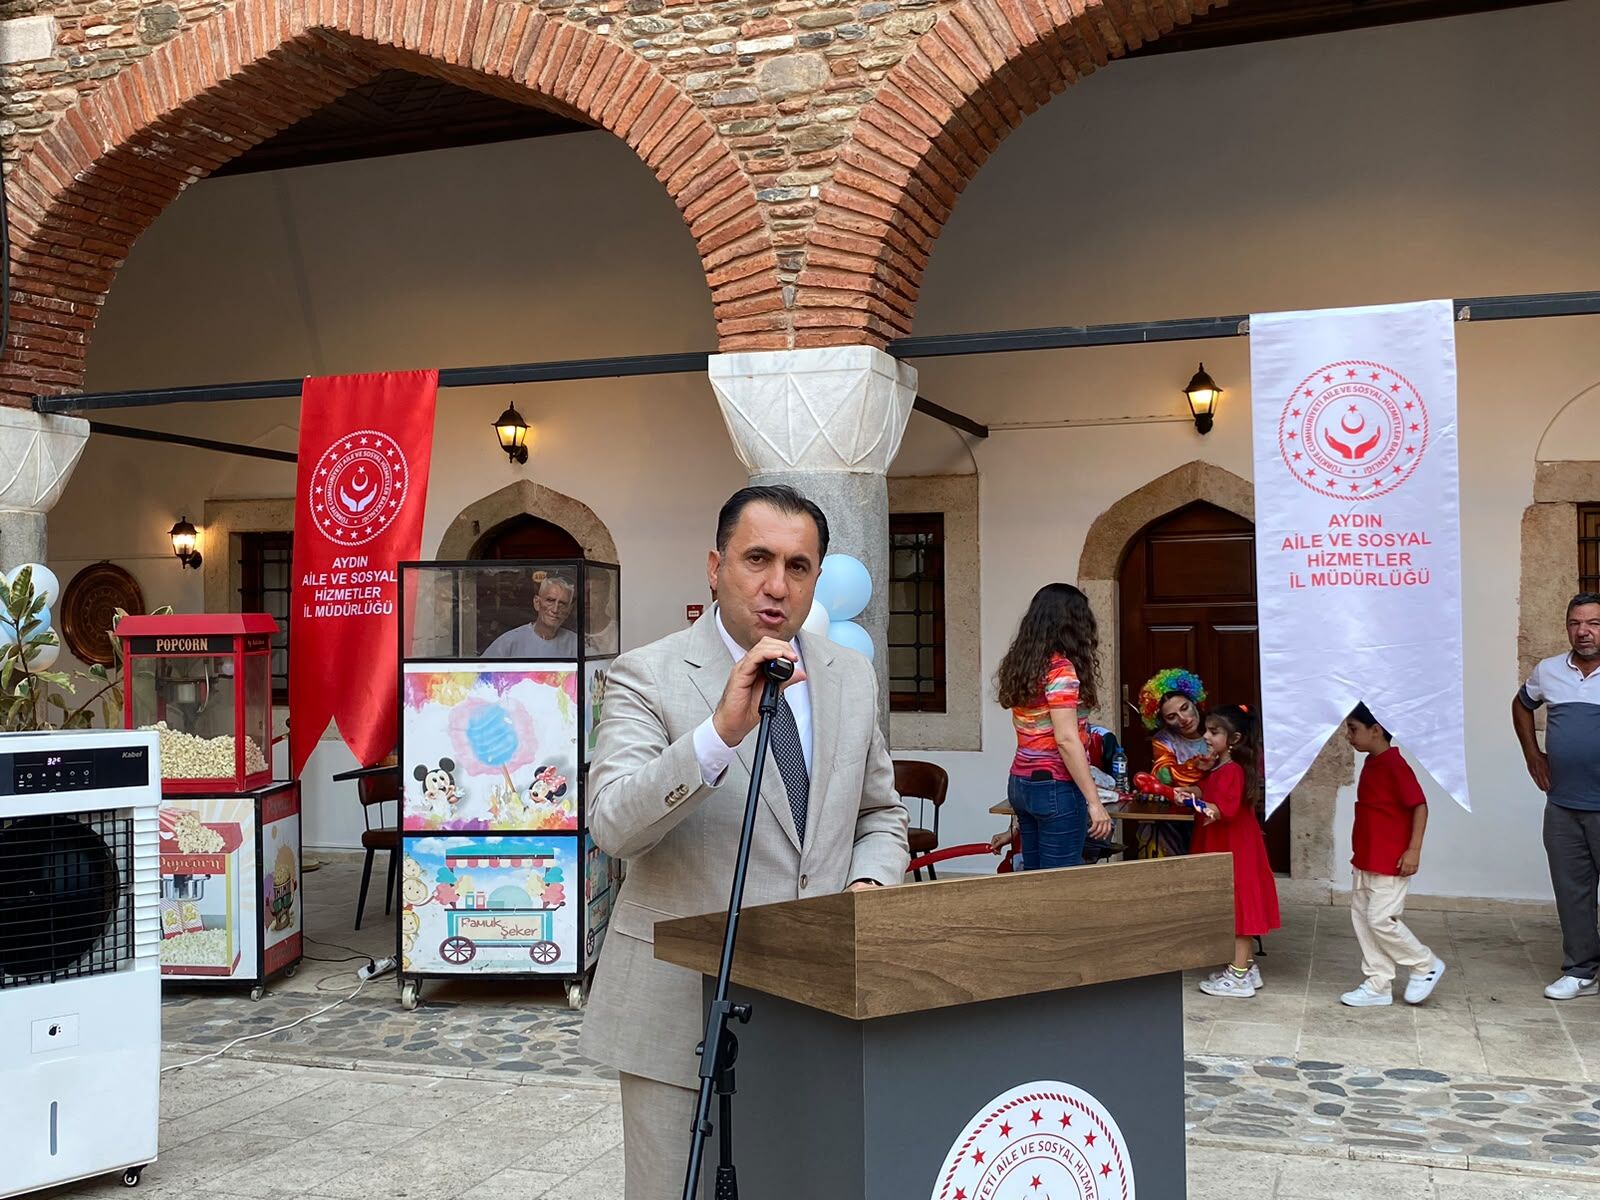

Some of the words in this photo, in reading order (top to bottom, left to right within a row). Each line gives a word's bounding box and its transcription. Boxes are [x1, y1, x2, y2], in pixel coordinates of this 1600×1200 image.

[1324, 388, 1340, 403] AİLE
[1340, 386, 1352, 394] VE
[1352, 385, 1383, 400] SOSYAL
[1328, 514, 1382, 528] AYDIN
[1282, 534, 1322, 550] AİLE
[1328, 533, 1352, 547] VE
[1358, 532, 1432, 547] SOSYAL
[332, 556, 368, 569] AYDIN
[1307, 550, 1412, 568] HİZMETLER
[302, 572, 327, 586] AİLE
[331, 572, 347, 585] VE
[350, 570, 397, 584] SOSYAL
[1290, 572, 1306, 588] İL
[1311, 568, 1430, 587] MÜDÜRLÜĞÜ
[315, 586, 381, 601] HİZMETLER
[304, 605, 312, 618] İL
[315, 600, 393, 617] MÜDÜRLÜĞÜ
[156, 638, 208, 652] POPCORN
[461, 917, 502, 928] Pamuk
[500, 925, 538, 940] Şeker
[996, 1151, 1019, 1176] AİLE
[1020, 1142, 1035, 1156] VE
[1038, 1140, 1074, 1163] SOSYAL
